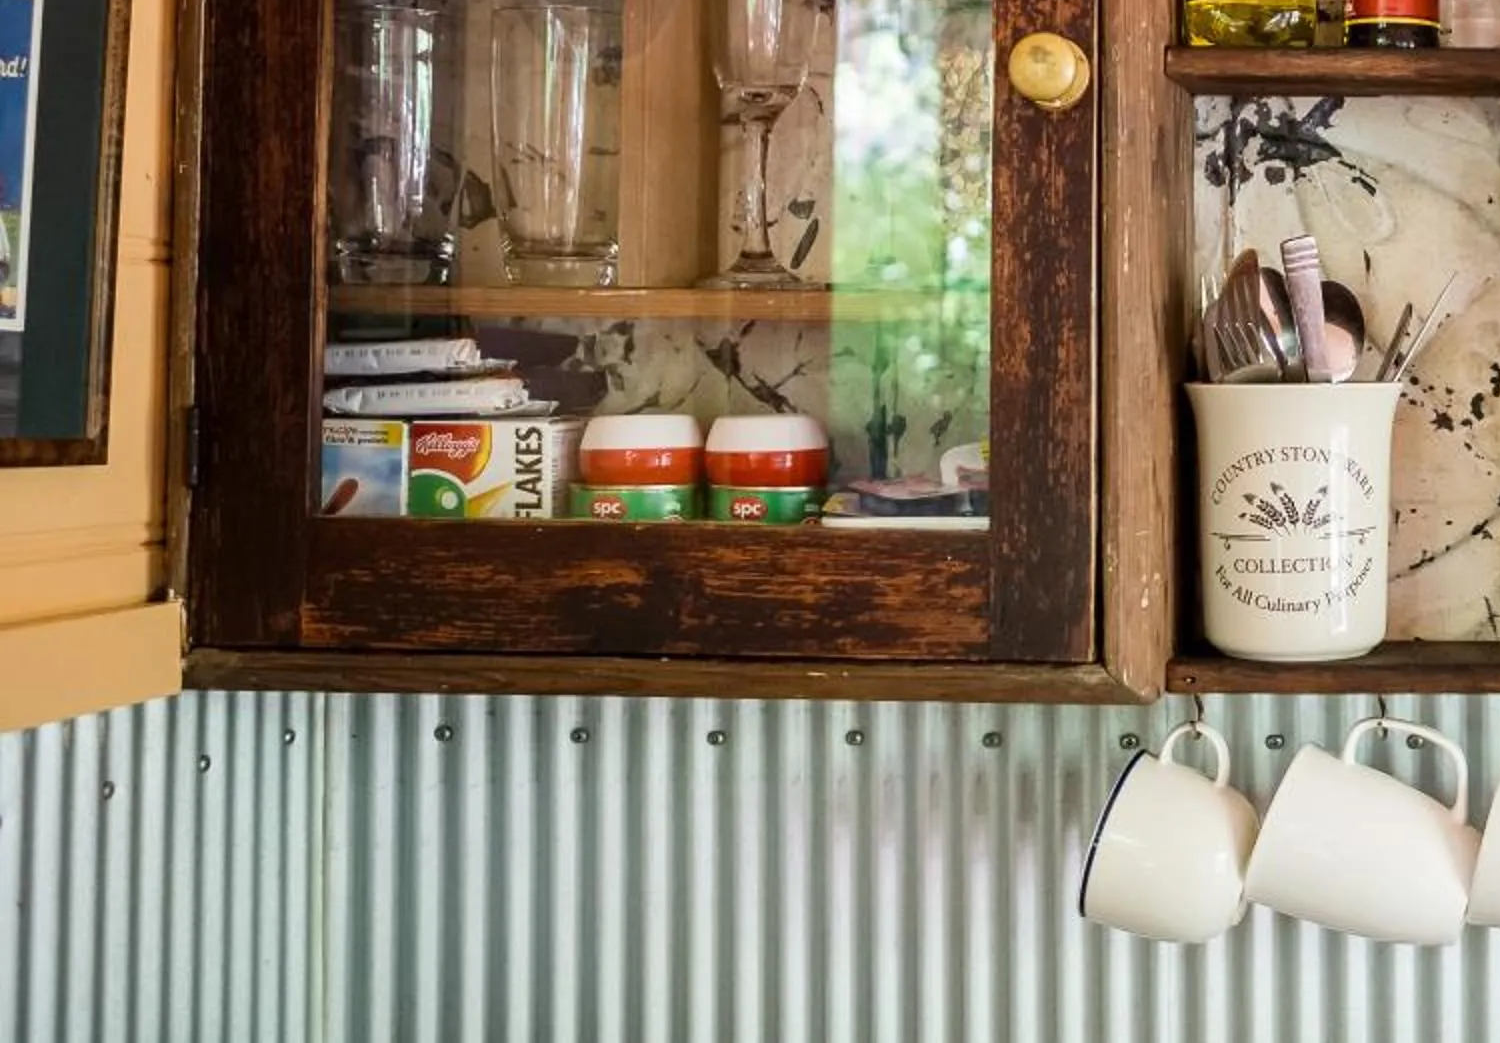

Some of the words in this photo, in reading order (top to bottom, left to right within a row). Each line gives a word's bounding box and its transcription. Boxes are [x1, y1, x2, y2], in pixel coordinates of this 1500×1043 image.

[1211, 448, 1276, 505] COUNTRY
[1280, 446, 1375, 499] STONARE
[592, 502, 621, 518] spc
[733, 502, 762, 518] spc
[1215, 564, 1233, 589] For
[1232, 586, 1254, 605] All
[1255, 594, 1321, 615] Culinary
